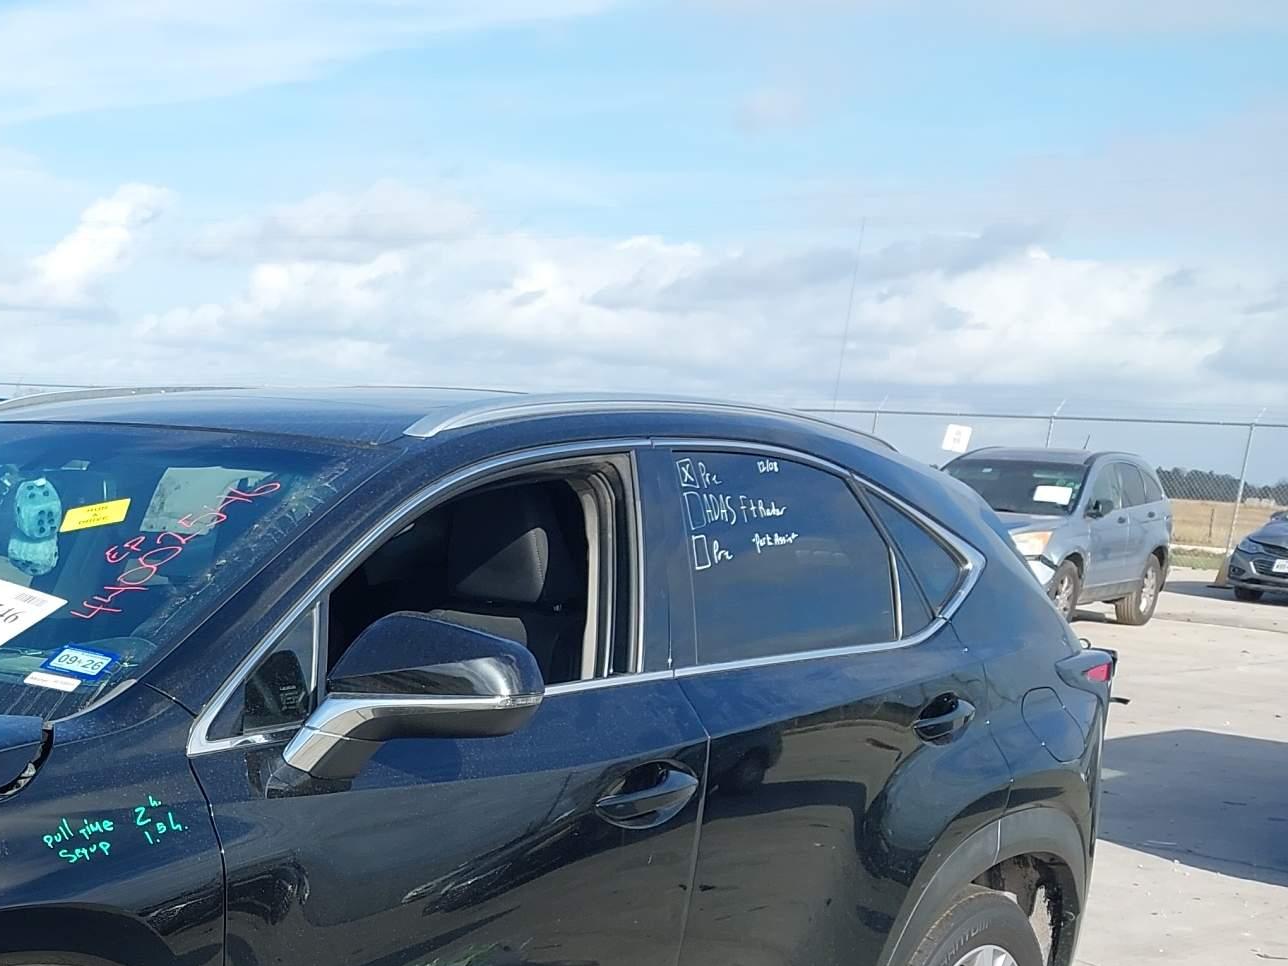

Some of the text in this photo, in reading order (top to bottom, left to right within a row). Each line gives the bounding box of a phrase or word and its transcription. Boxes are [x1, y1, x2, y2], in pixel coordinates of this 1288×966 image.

[703, 493, 736, 525] ADAS
[70, 482, 280, 618] 44002546
[57, 653, 104, 670] 09 26
